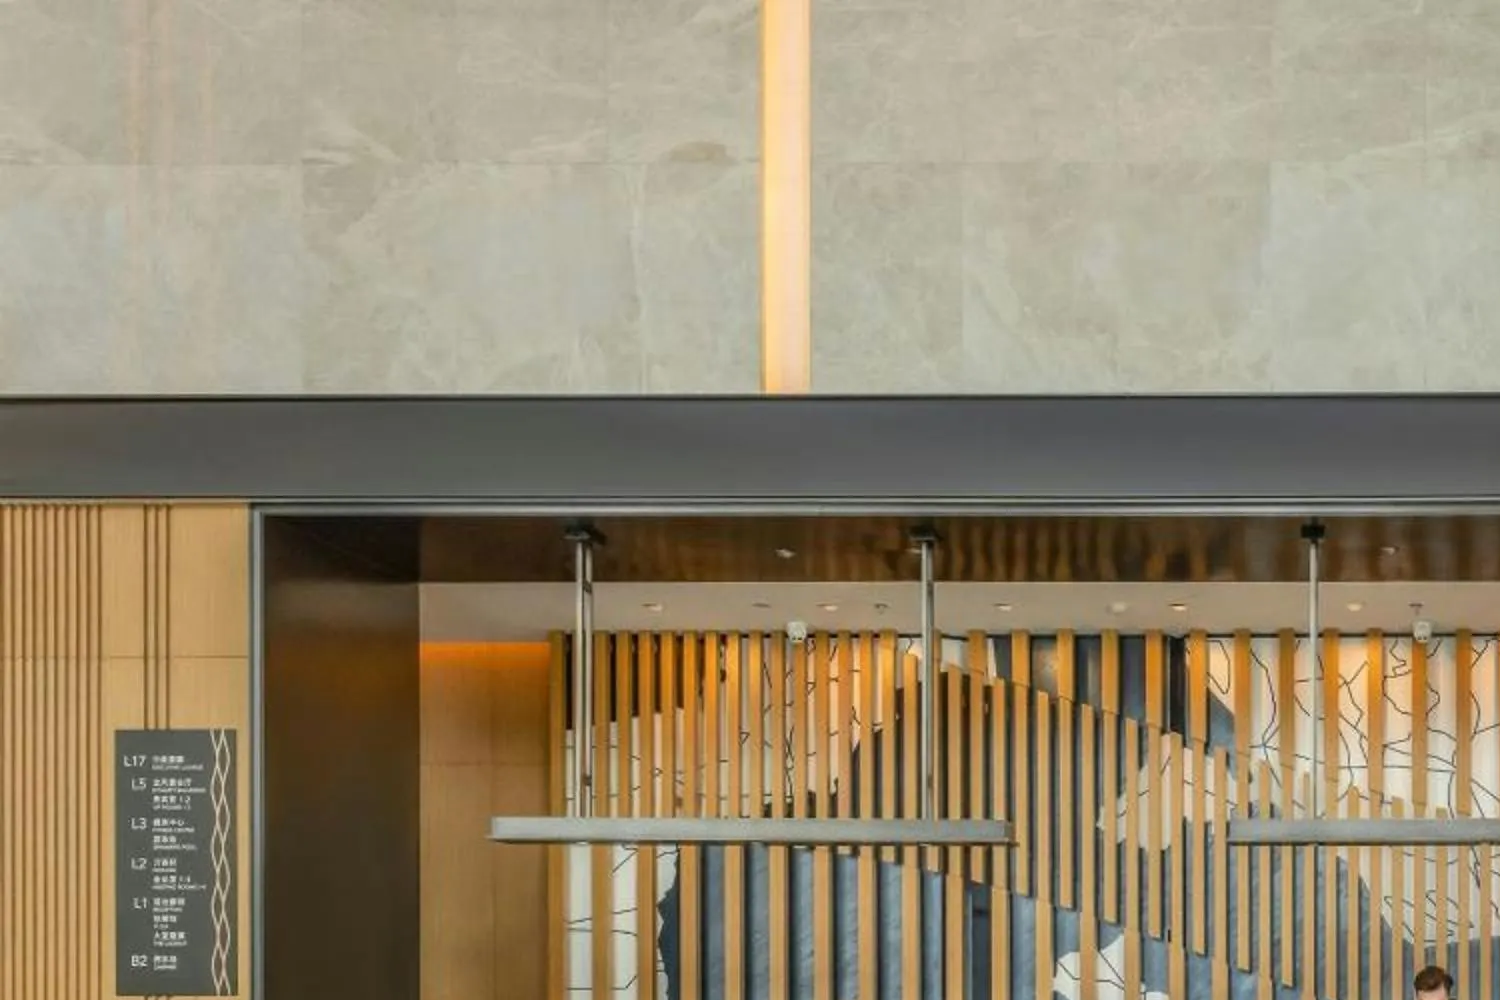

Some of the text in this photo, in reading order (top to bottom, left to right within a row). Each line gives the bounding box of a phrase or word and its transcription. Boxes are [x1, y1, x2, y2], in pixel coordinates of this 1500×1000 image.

[123, 755, 147, 767] L17
[131, 777, 147, 790] L5
[131, 818, 147, 829] L3
[131, 858, 147, 870] L2
[133, 898, 147, 909] L1
[131, 955, 148, 967] B2
